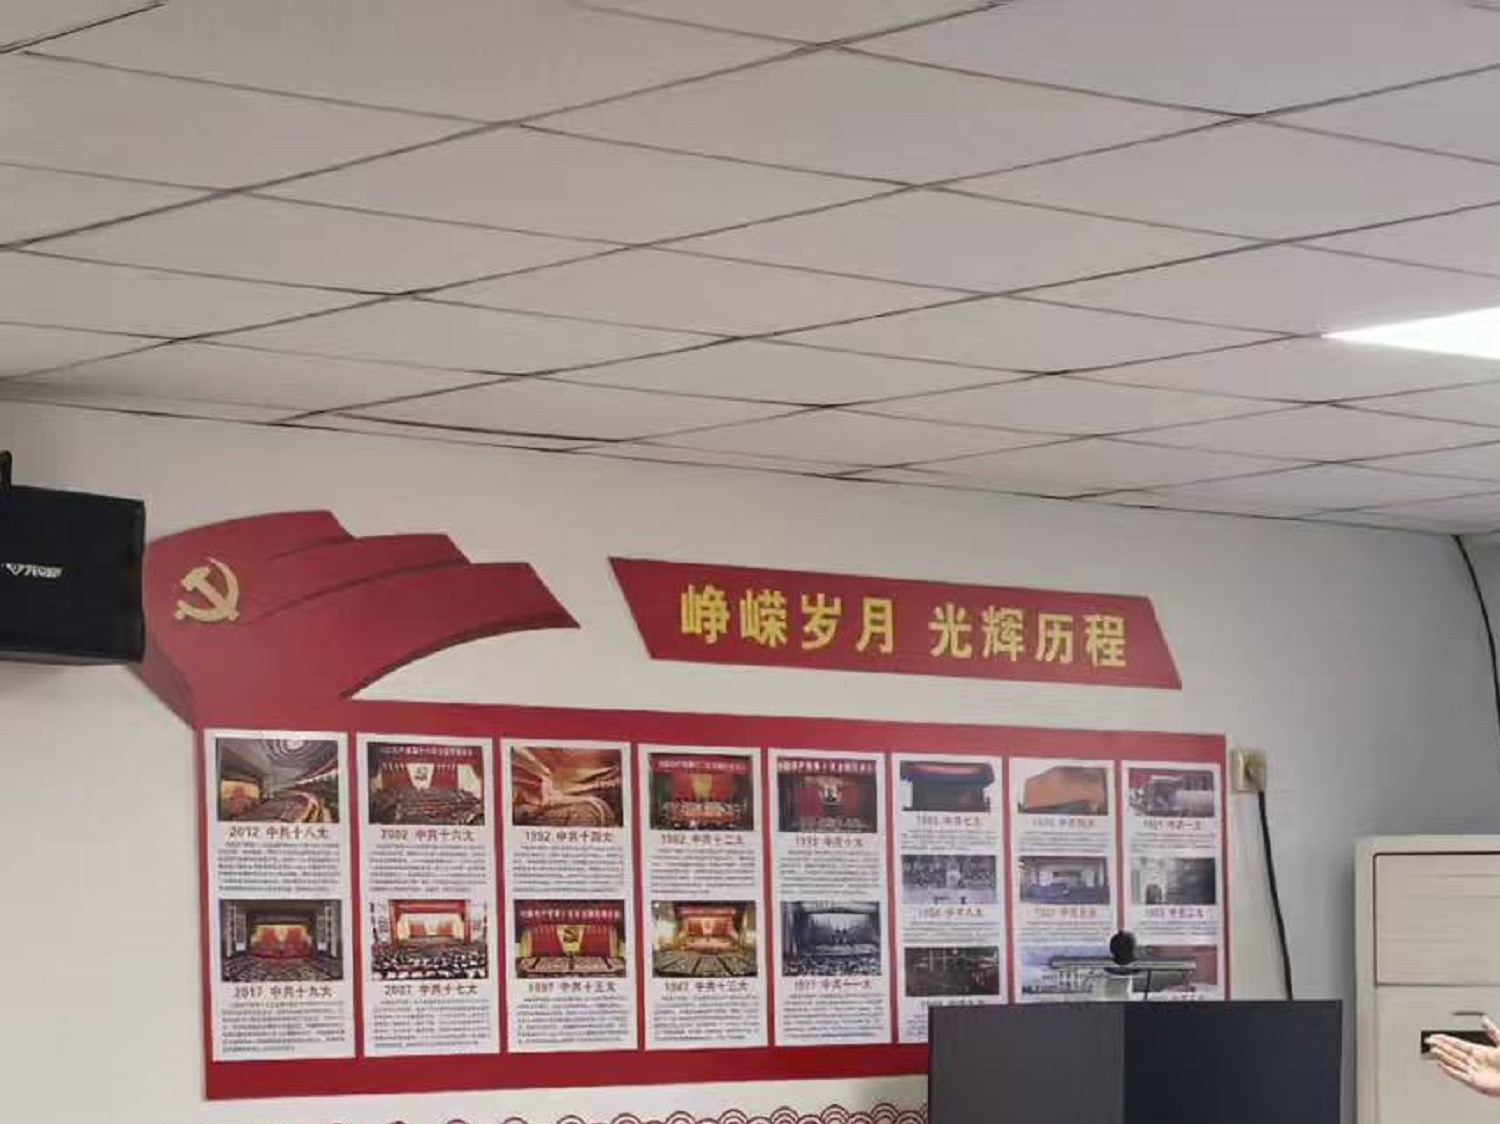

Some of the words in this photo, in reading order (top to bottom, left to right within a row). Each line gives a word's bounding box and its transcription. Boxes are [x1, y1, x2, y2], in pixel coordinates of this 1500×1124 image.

[681, 584, 895, 654] 峥嵘岁月
[929, 602, 1126, 668] 光辉历程
[228, 826, 259, 838] 2012
[266, 826, 330, 839] 中共十八大
[233, 986, 263, 998] 2017
[270, 986, 333, 998] 中共十九大
[419, 984, 479, 996] 中共十七大
